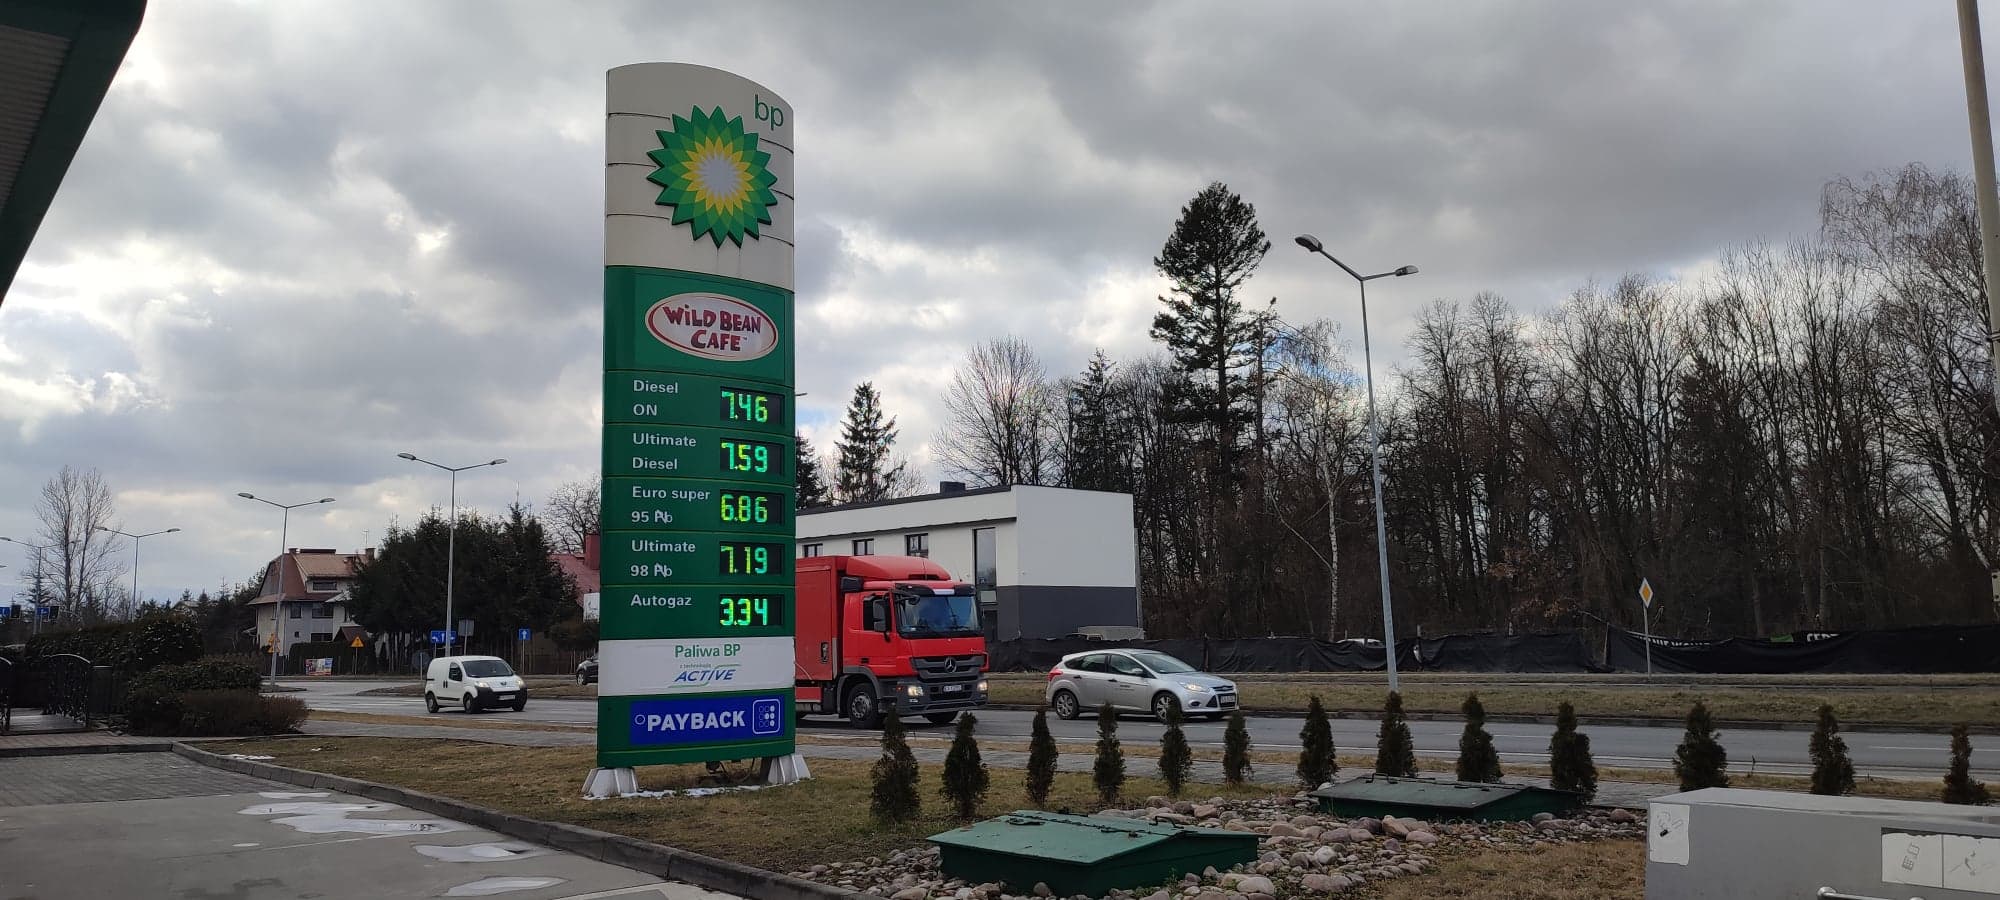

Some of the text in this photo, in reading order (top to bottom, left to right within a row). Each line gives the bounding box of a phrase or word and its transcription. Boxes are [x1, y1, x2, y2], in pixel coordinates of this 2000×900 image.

[755, 94, 783, 131] bp
[720, 310, 760, 334] BEAN
[633, 379, 679, 394] Diesel
[633, 403, 658, 417] ON
[721, 390, 768, 423] 7.46
[632, 432, 697, 448] Ultimate
[632, 457, 678, 470] Diesel
[721, 442, 768, 473] 7.59
[632, 485, 711, 502] Euro super
[720, 493, 768, 523] 6.86
[631, 510, 650, 523] 95
[631, 539, 697, 553] Ultimate
[720, 545, 768, 574] 7.19
[630, 564, 649, 577] 98
[630, 593, 692, 609] Autogaz
[720, 598, 768, 626] 3.34
[674, 643, 741, 658] Paliwa BP
[674, 669, 737, 682] ACTIVE
[647, 710, 746, 732] PAYBACK
